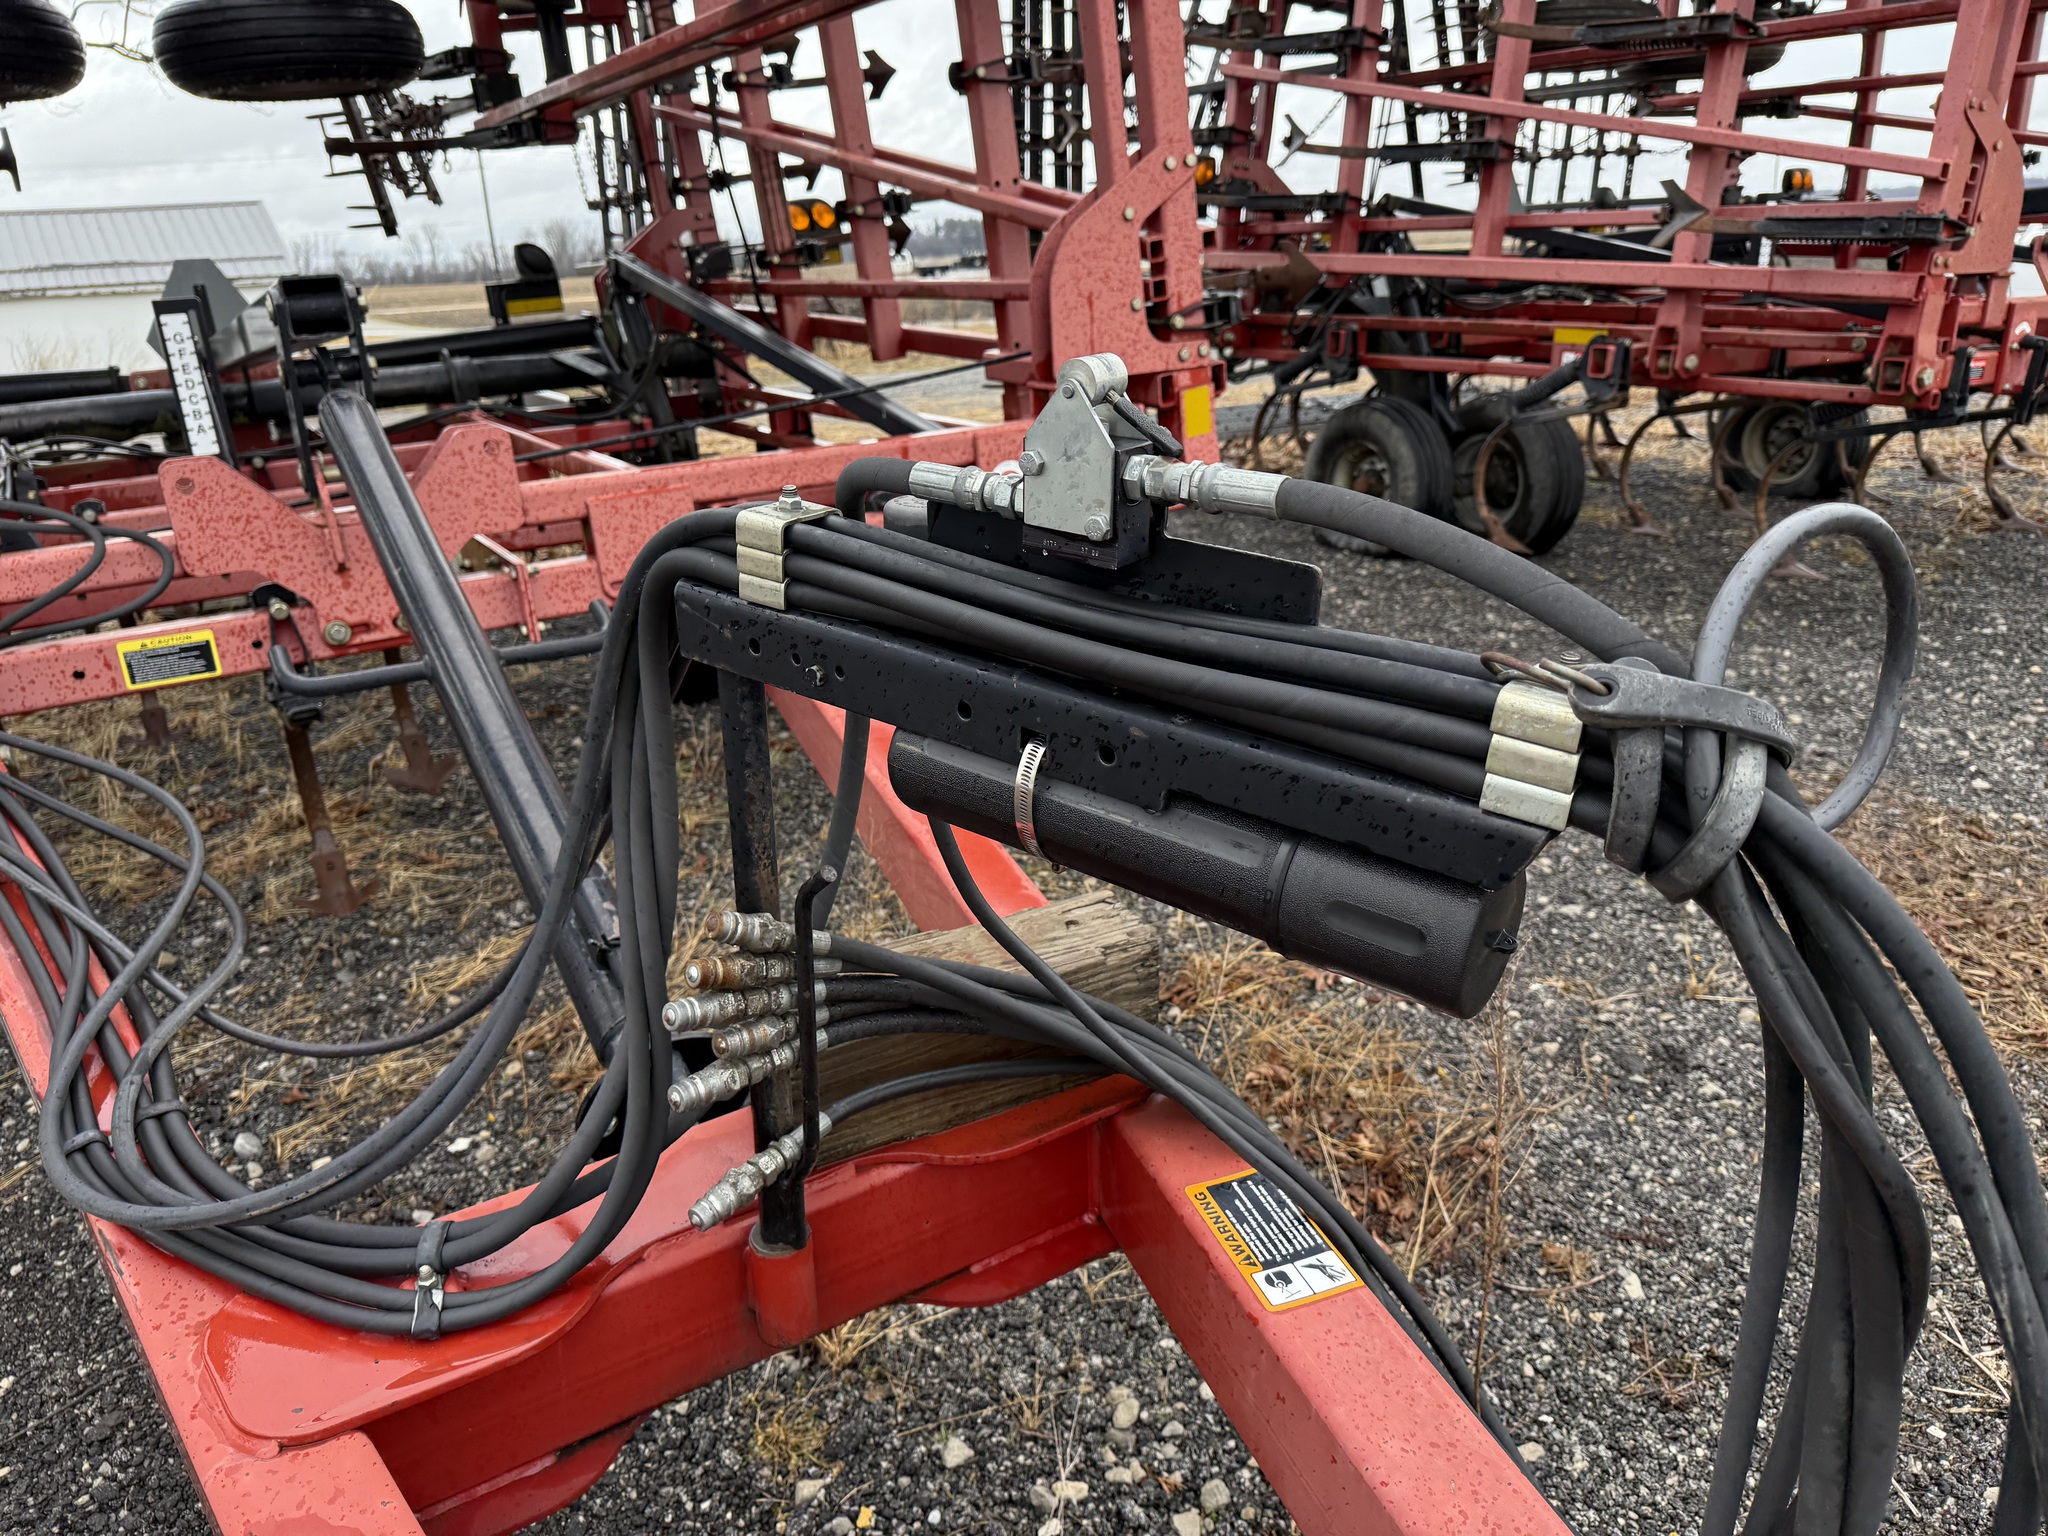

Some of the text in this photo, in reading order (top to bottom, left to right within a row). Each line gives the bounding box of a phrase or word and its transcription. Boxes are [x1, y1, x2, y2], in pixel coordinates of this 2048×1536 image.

[173, 332, 207, 436] G F E D C B A
[150, 635, 192, 647] CAUTION
[1194, 1191, 1246, 1257] WARNING
